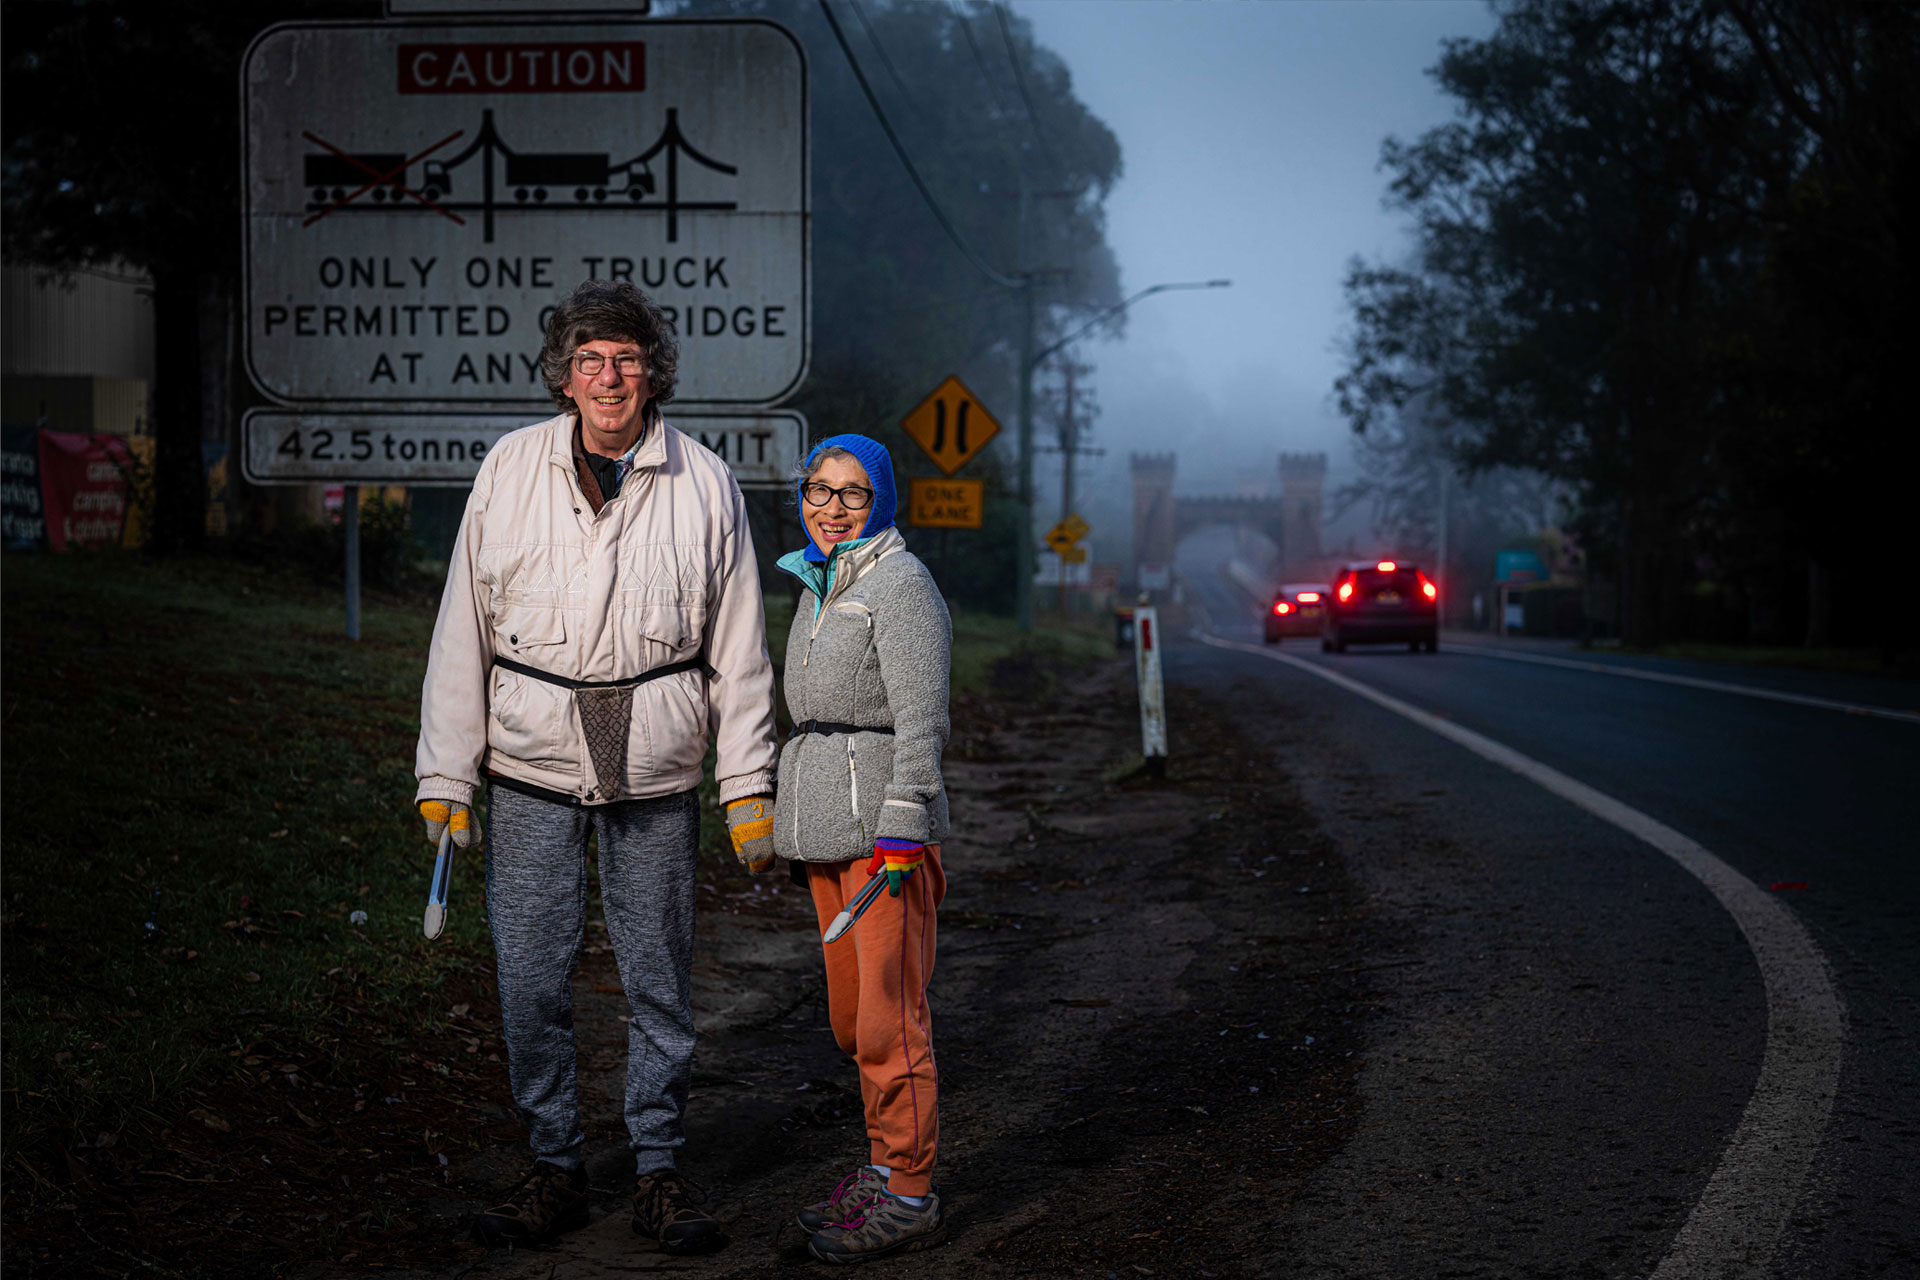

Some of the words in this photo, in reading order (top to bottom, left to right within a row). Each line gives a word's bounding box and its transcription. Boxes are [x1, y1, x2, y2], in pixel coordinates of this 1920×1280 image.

[412, 50, 632, 88] CAUTION
[319, 257, 437, 289] ONLY
[466, 257, 554, 288] ONE
[582, 257, 729, 288] TRUCK
[265, 306, 510, 336] PERMITTED
[660, 306, 787, 337] RIDGE
[370, 353, 424, 384] AT
[453, 353, 540, 384] ANY
[700, 431, 772, 463] MIT
[926, 486, 966, 501] ONE
[918, 504, 970, 520] LANE
